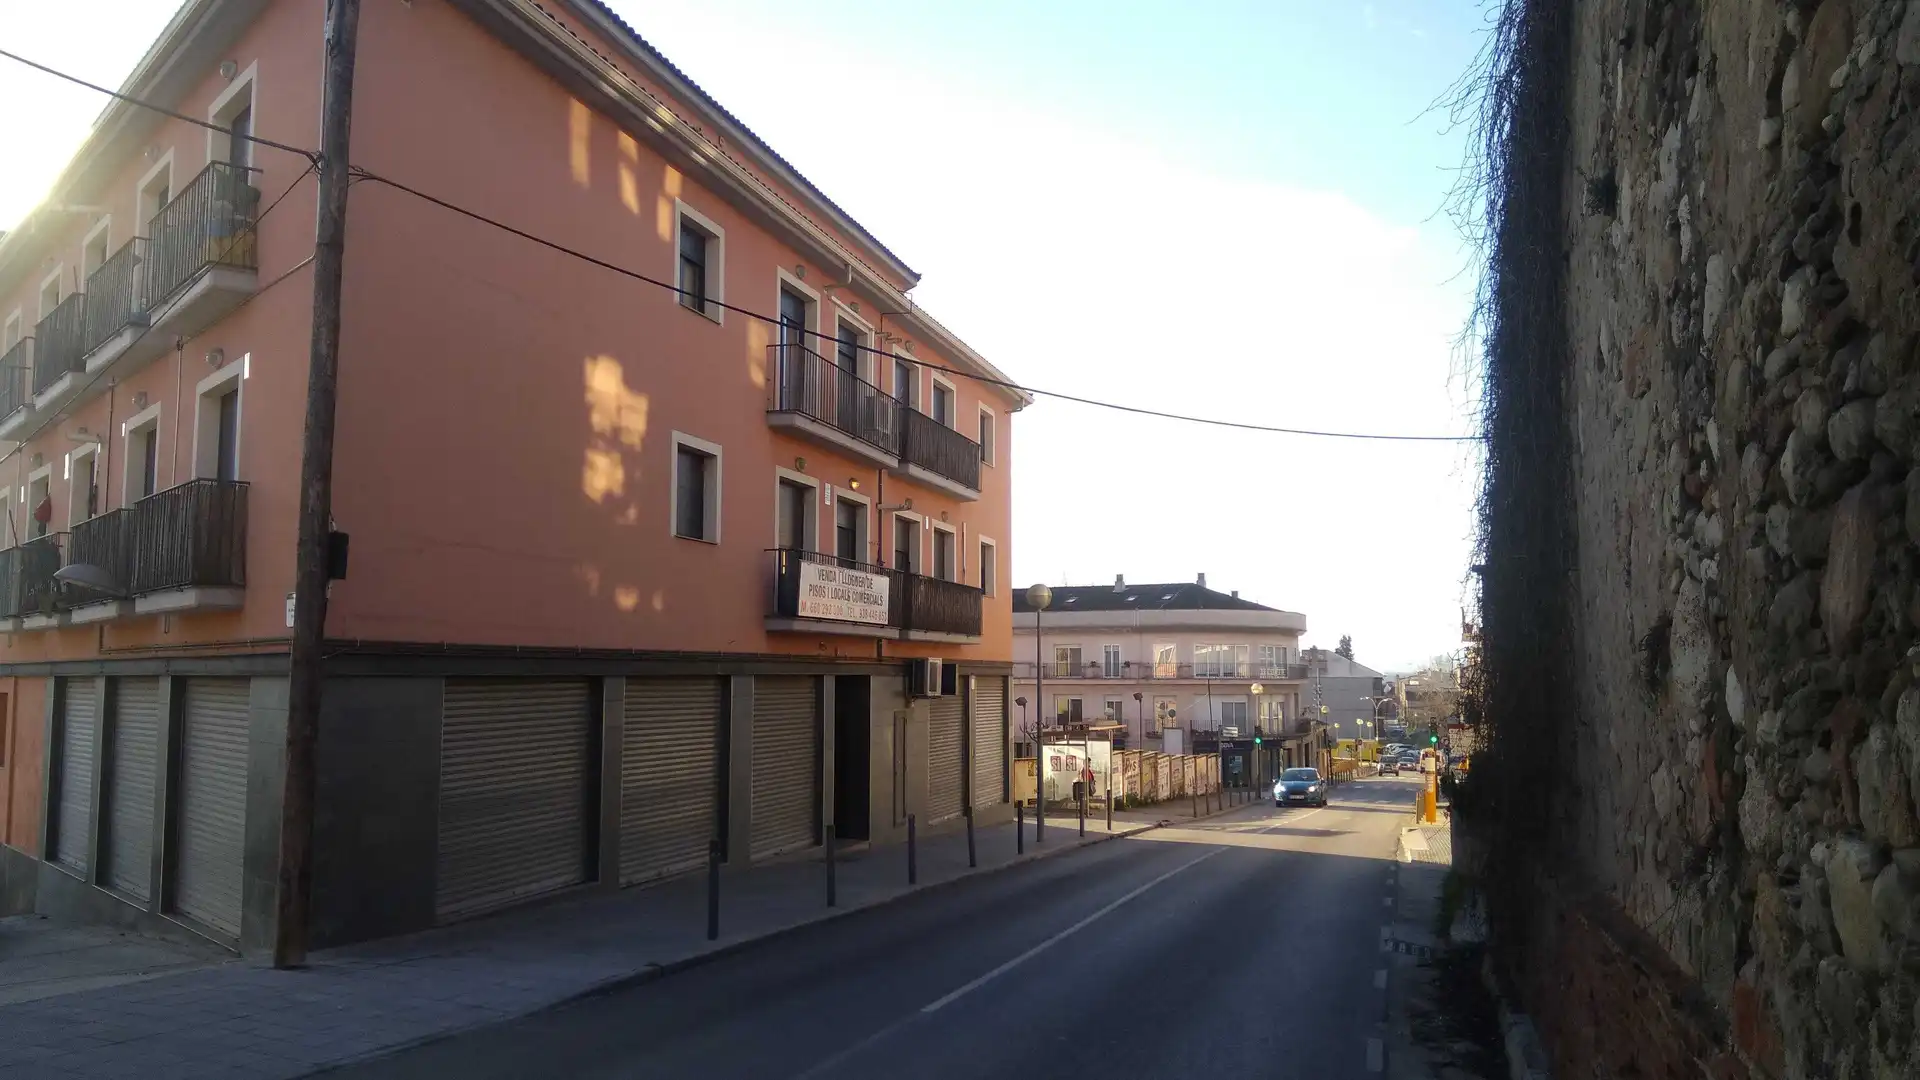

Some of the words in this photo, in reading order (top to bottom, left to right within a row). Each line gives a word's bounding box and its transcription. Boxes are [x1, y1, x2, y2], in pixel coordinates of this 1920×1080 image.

[818, 568, 837, 583] VENDA
[809, 584, 826, 599] PISOS
[831, 587, 851, 602] LOCALS
[852, 590, 884, 606] COMERCIALS
